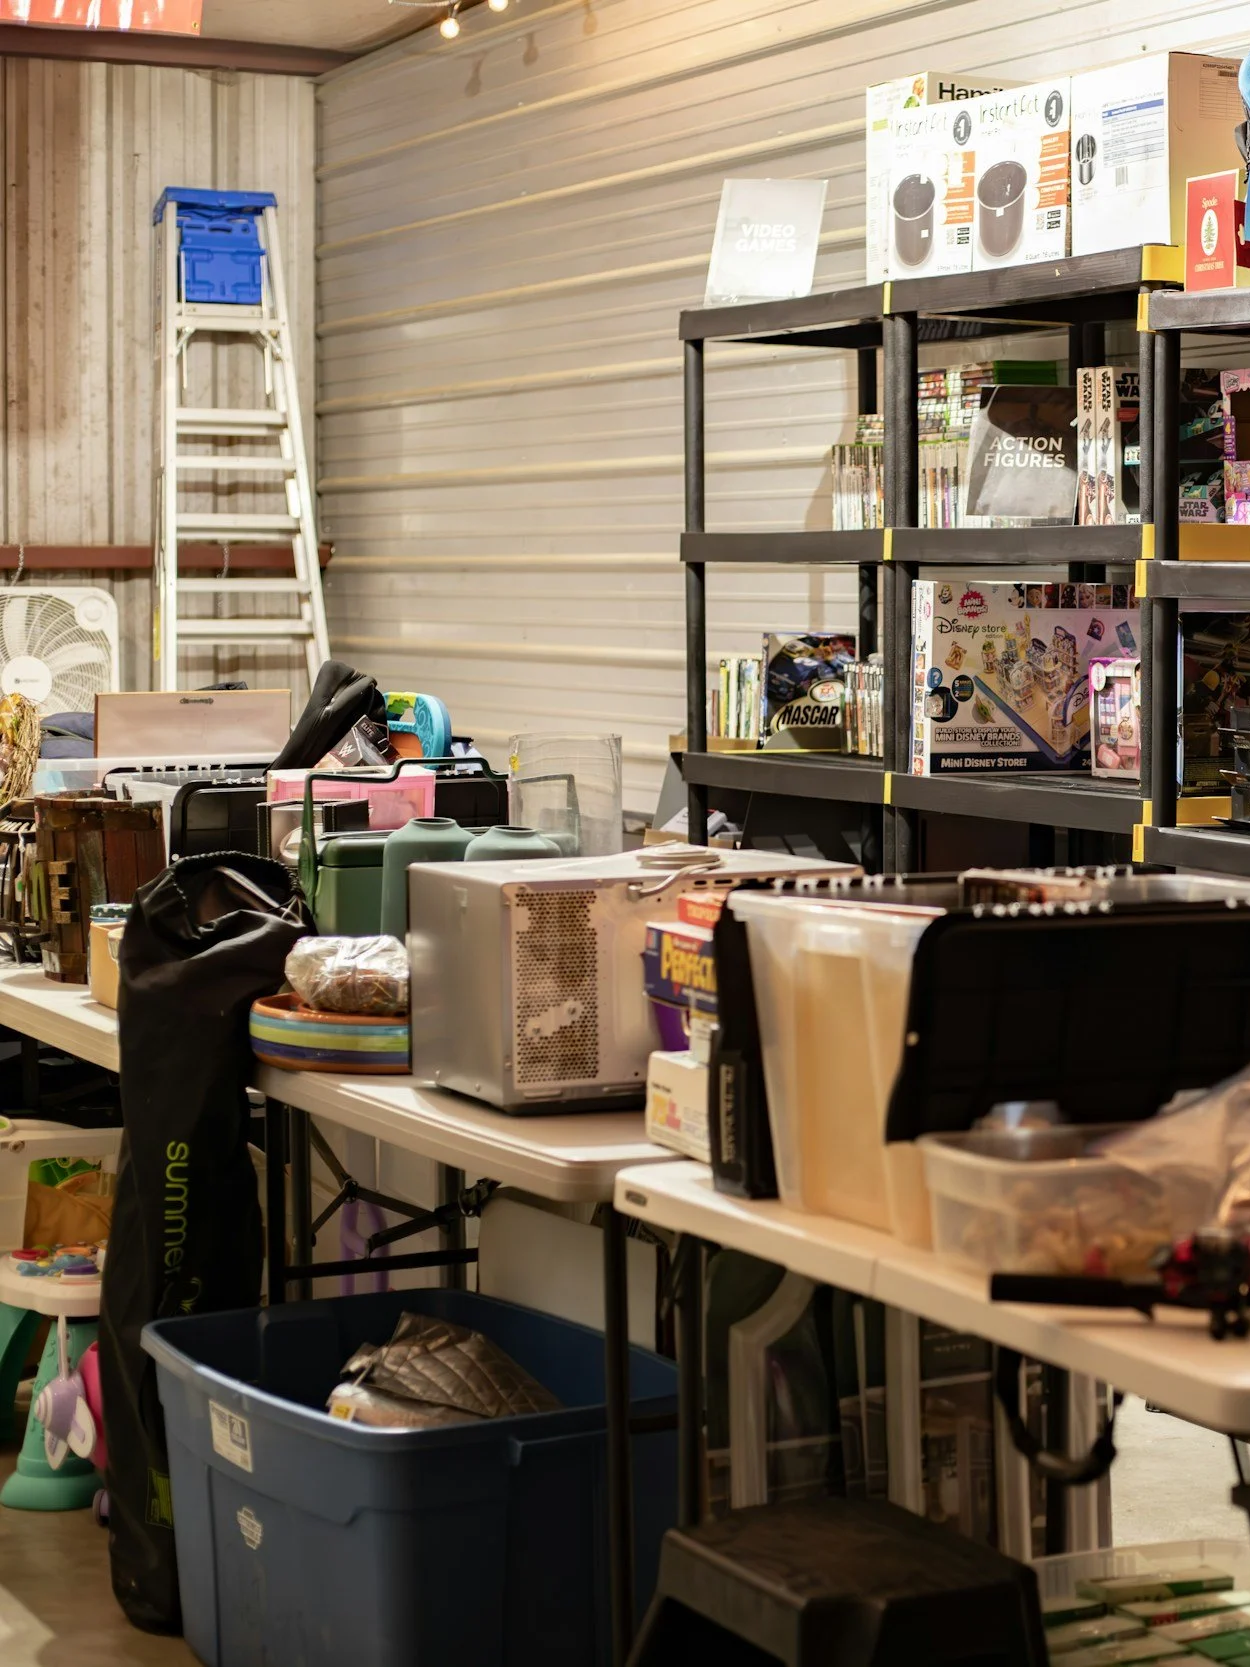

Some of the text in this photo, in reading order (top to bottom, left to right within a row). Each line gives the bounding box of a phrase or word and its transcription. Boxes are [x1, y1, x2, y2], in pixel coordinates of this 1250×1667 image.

[1202, 197, 1218, 209] Spode
[741, 223, 796, 238] VIDEO
[735, 238, 797, 252] GAMES
[990, 436, 1062, 452] ACTION
[984, 452, 1066, 469] FIGURES
[1180, 501, 1209, 510] STAR
[1180, 509, 1209, 517] WARS
[982, 623, 1007, 633] store
[780, 705, 839, 725] NASCAR
[361, 722, 375, 737] ELITE
[956, 733, 987, 741] DISNEY
[987, 733, 1021, 741] BRANDS
[964, 758, 996, 768] DISNEY
[997, 757, 1027, 767] STORE!
[164, 1141, 190, 1275] summer
